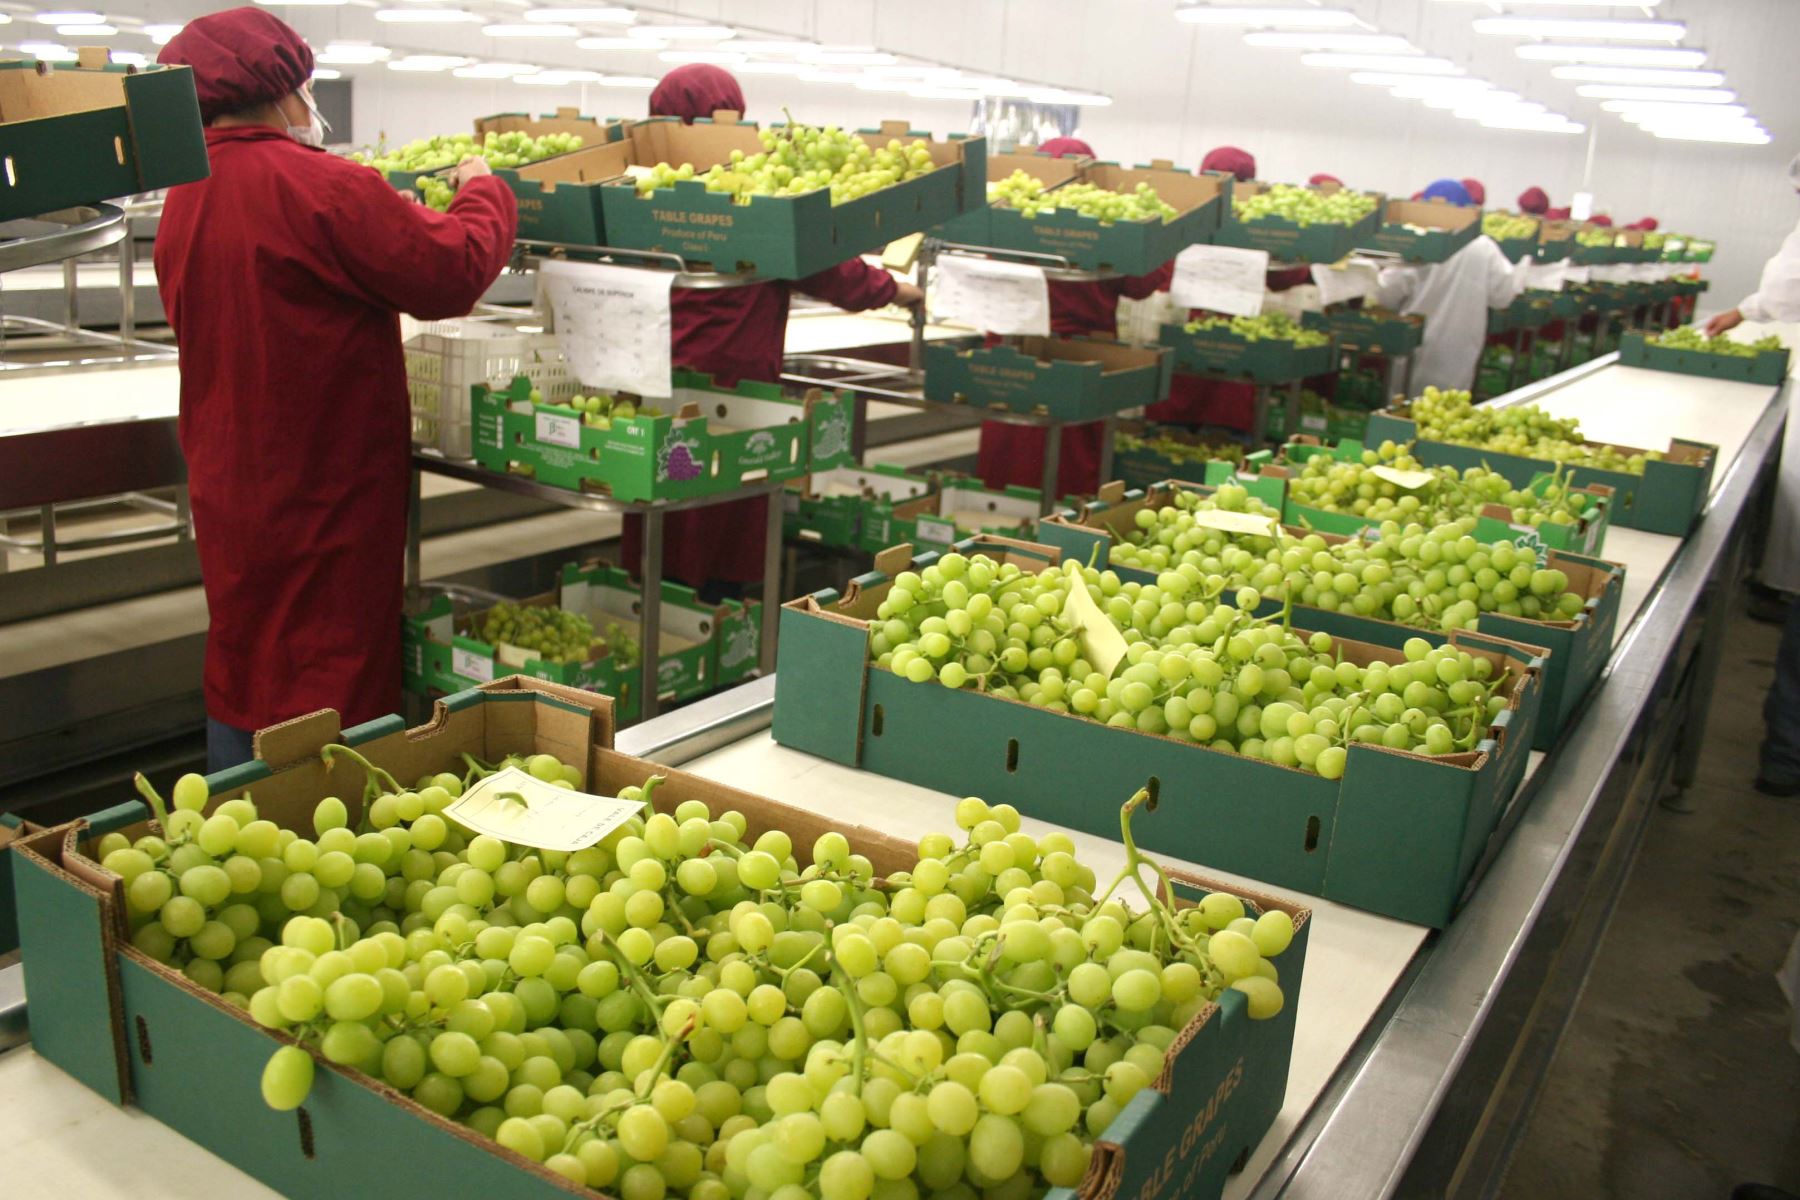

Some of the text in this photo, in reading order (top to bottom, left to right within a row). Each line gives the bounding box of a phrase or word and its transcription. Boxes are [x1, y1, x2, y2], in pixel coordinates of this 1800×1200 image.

[652, 209, 733, 227] TABLE GRAPES
[662, 227, 695, 239] Produce
[707, 231, 727, 242] Peru
[1180, 1056, 1244, 1160] GRAPES
